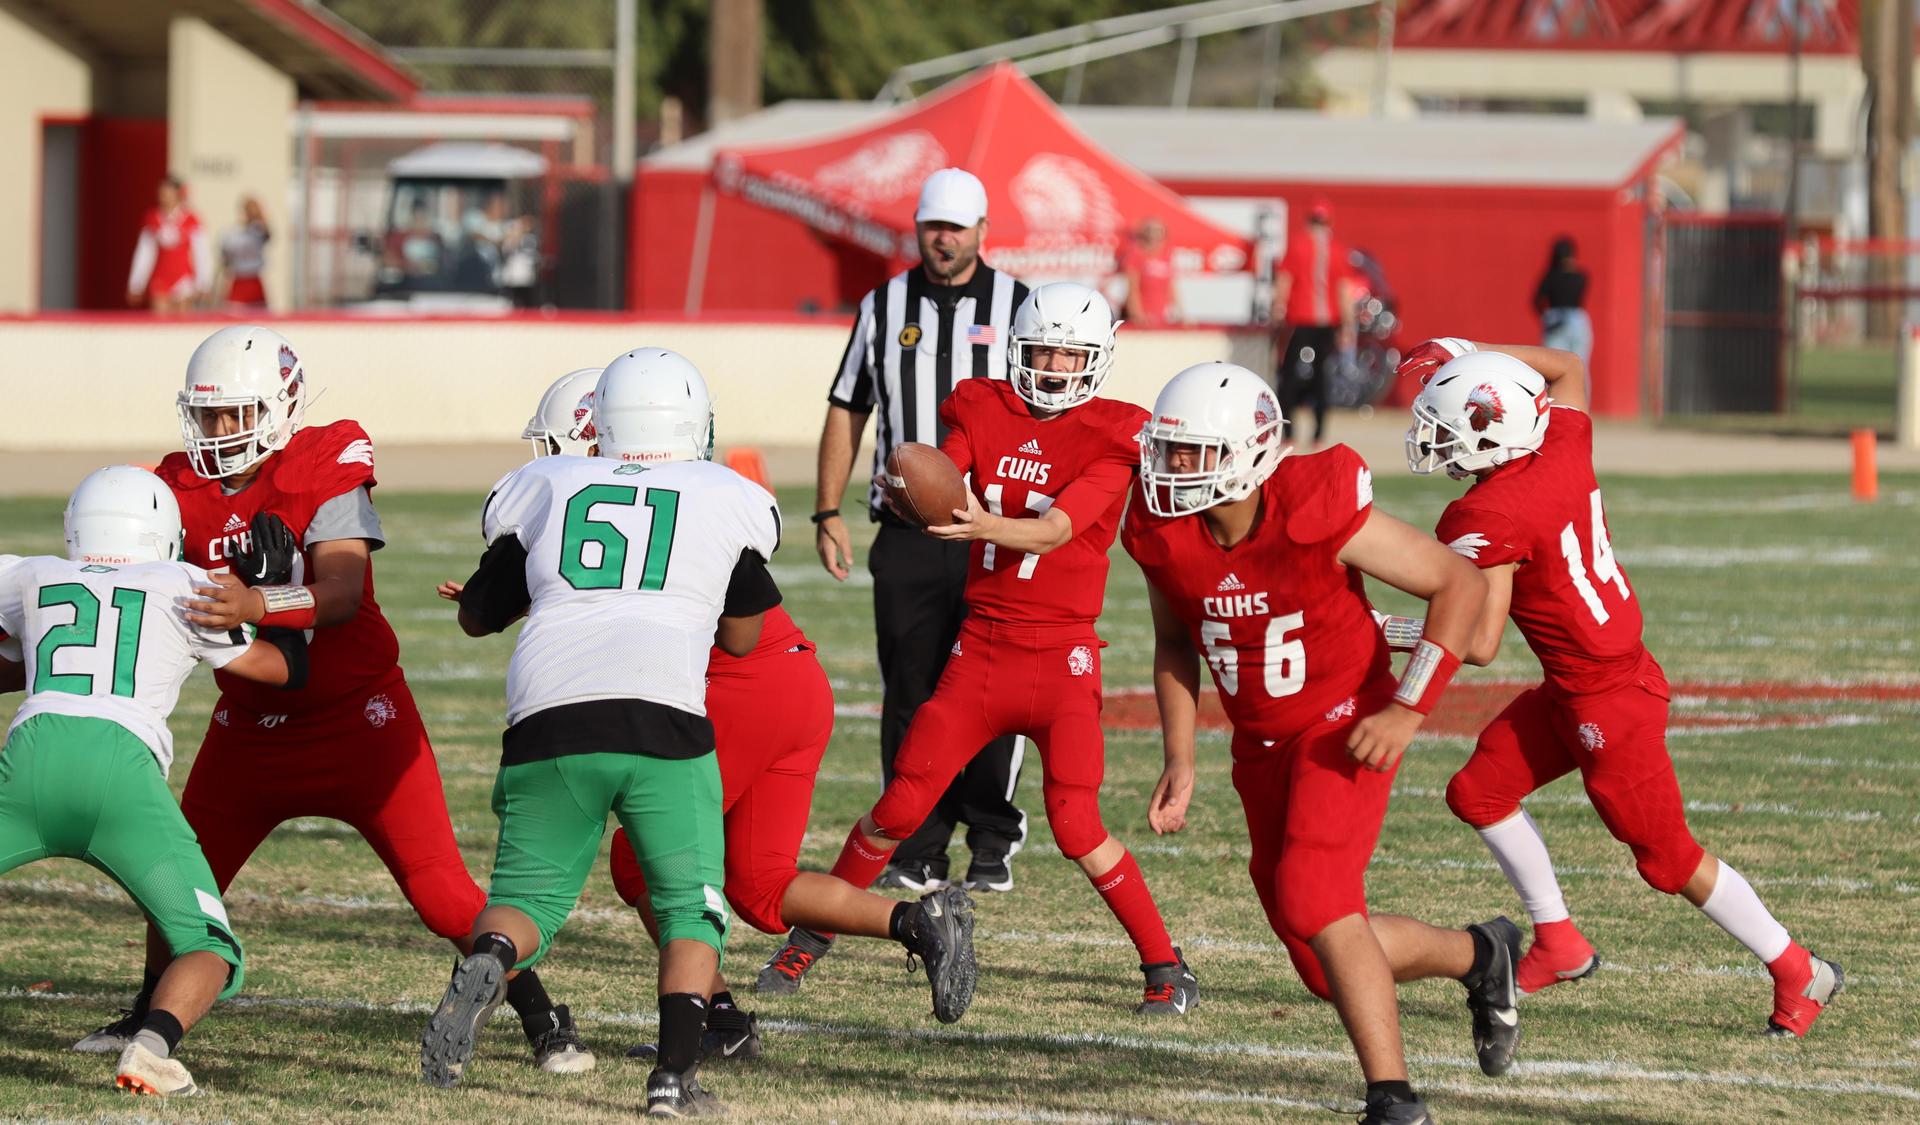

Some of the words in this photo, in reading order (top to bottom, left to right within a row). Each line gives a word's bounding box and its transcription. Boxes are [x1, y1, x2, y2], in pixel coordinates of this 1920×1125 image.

[996, 455, 1052, 485] CUHS
[208, 529, 254, 561] CUH
[558, 484, 680, 591] 61
[1560, 488, 1630, 626] 14
[33, 582, 147, 698] 21
[1203, 591, 1270, 617] CUHS
[1201, 610, 1305, 698] 56
